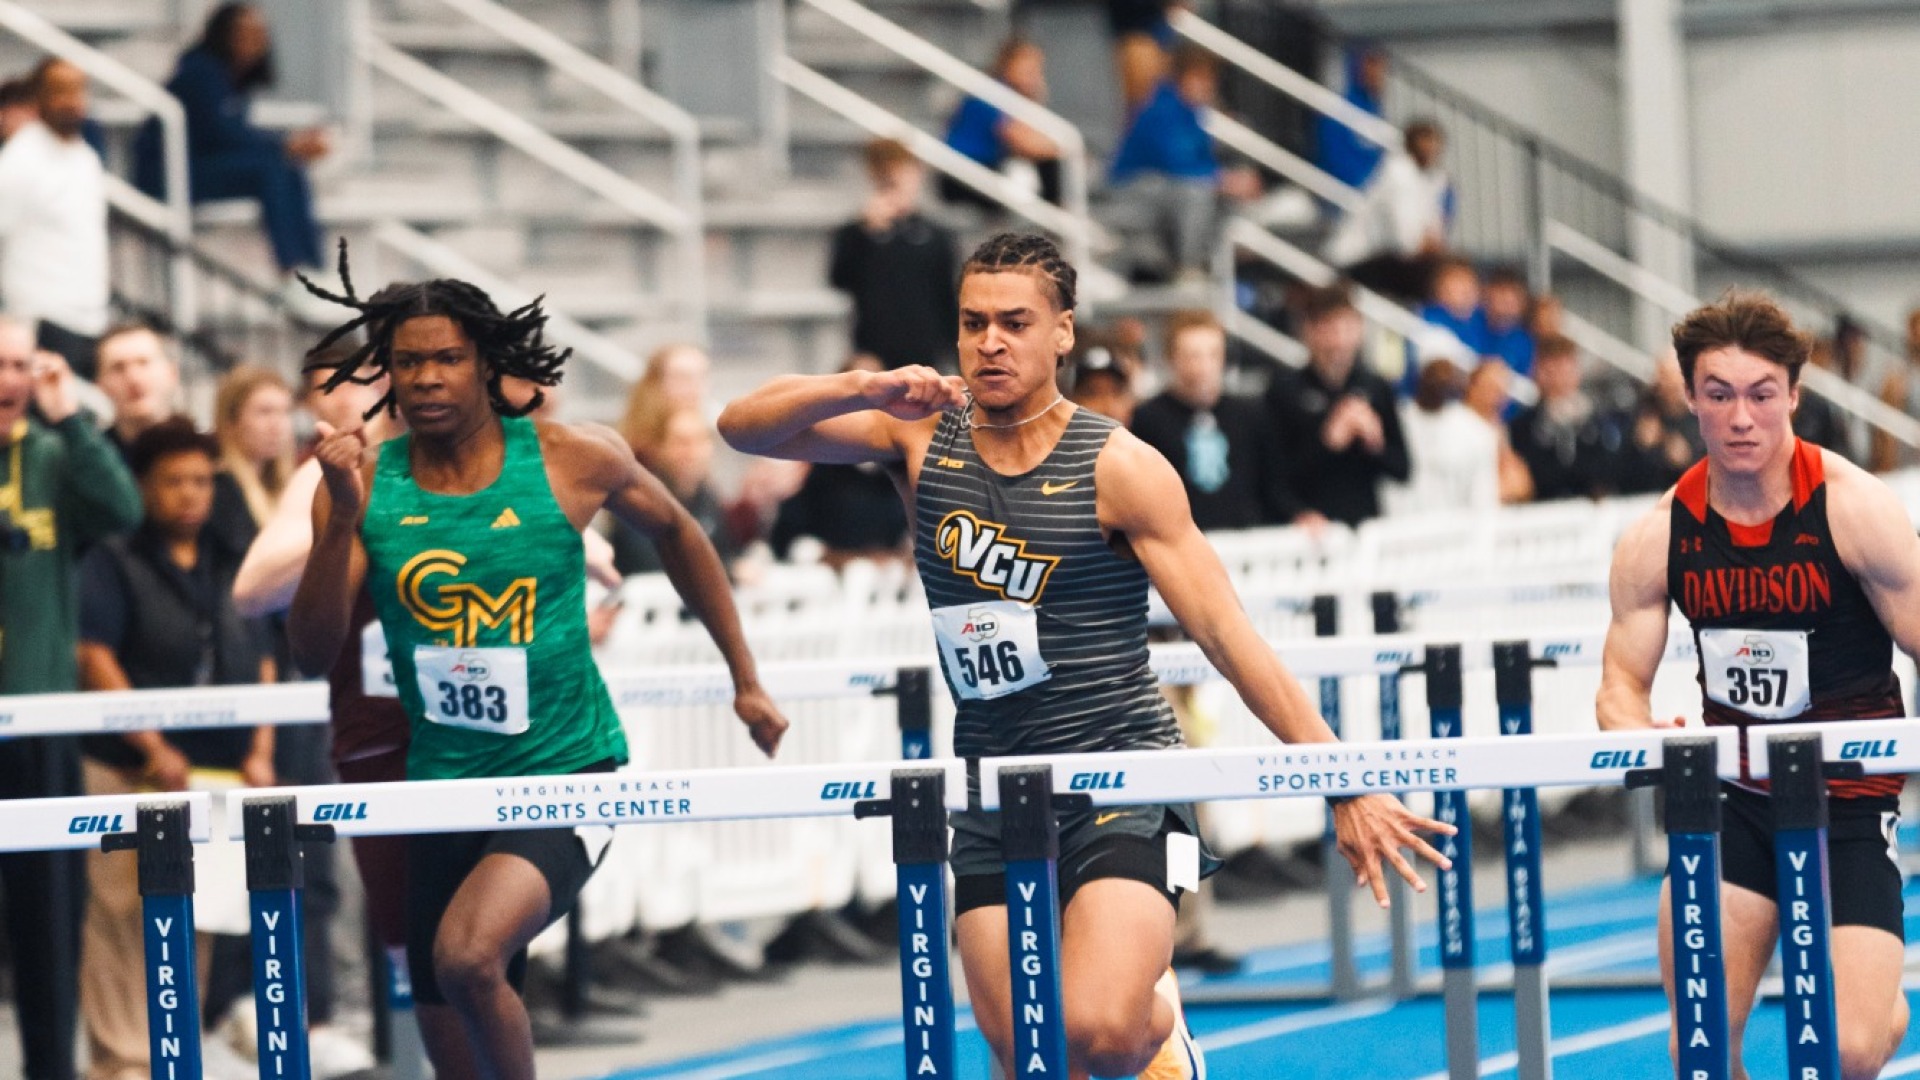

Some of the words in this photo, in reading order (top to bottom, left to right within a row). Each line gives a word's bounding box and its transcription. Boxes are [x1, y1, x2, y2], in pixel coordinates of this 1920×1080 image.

[937, 511, 1060, 604] VCU
[397, 549, 537, 648] GM
[1684, 562, 1831, 618] DAVIDSON
[954, 640, 1025, 688] 546
[438, 681, 508, 723] 383
[1726, 667, 1788, 707] 357
[1258, 752, 1365, 766] VIRGINIA
[1385, 749, 1457, 761] BEACH
[1590, 750, 1647, 769] GILL
[1840, 740, 1897, 759] GILL
[497, 785, 601, 796] VIRGINIA
[620, 780, 690, 792] BEACH
[821, 781, 877, 799] GILL
[1070, 772, 1126, 789] GILL
[1259, 772, 1349, 791] SPORTS
[1363, 768, 1457, 787] CENTER
[68, 815, 124, 834] GILL
[314, 802, 367, 821] GILL
[497, 803, 586, 822] SPORTS
[598, 799, 691, 818] CENTER
[1681, 855, 1710, 1047] VIRGINIA
[1789, 851, 1819, 1044] VIRGINIA
[262, 911, 287, 1080] VIRGINI
[909, 884, 937, 1075] VIRGINIA
[1017, 881, 1046, 1073] VIRGINIA
